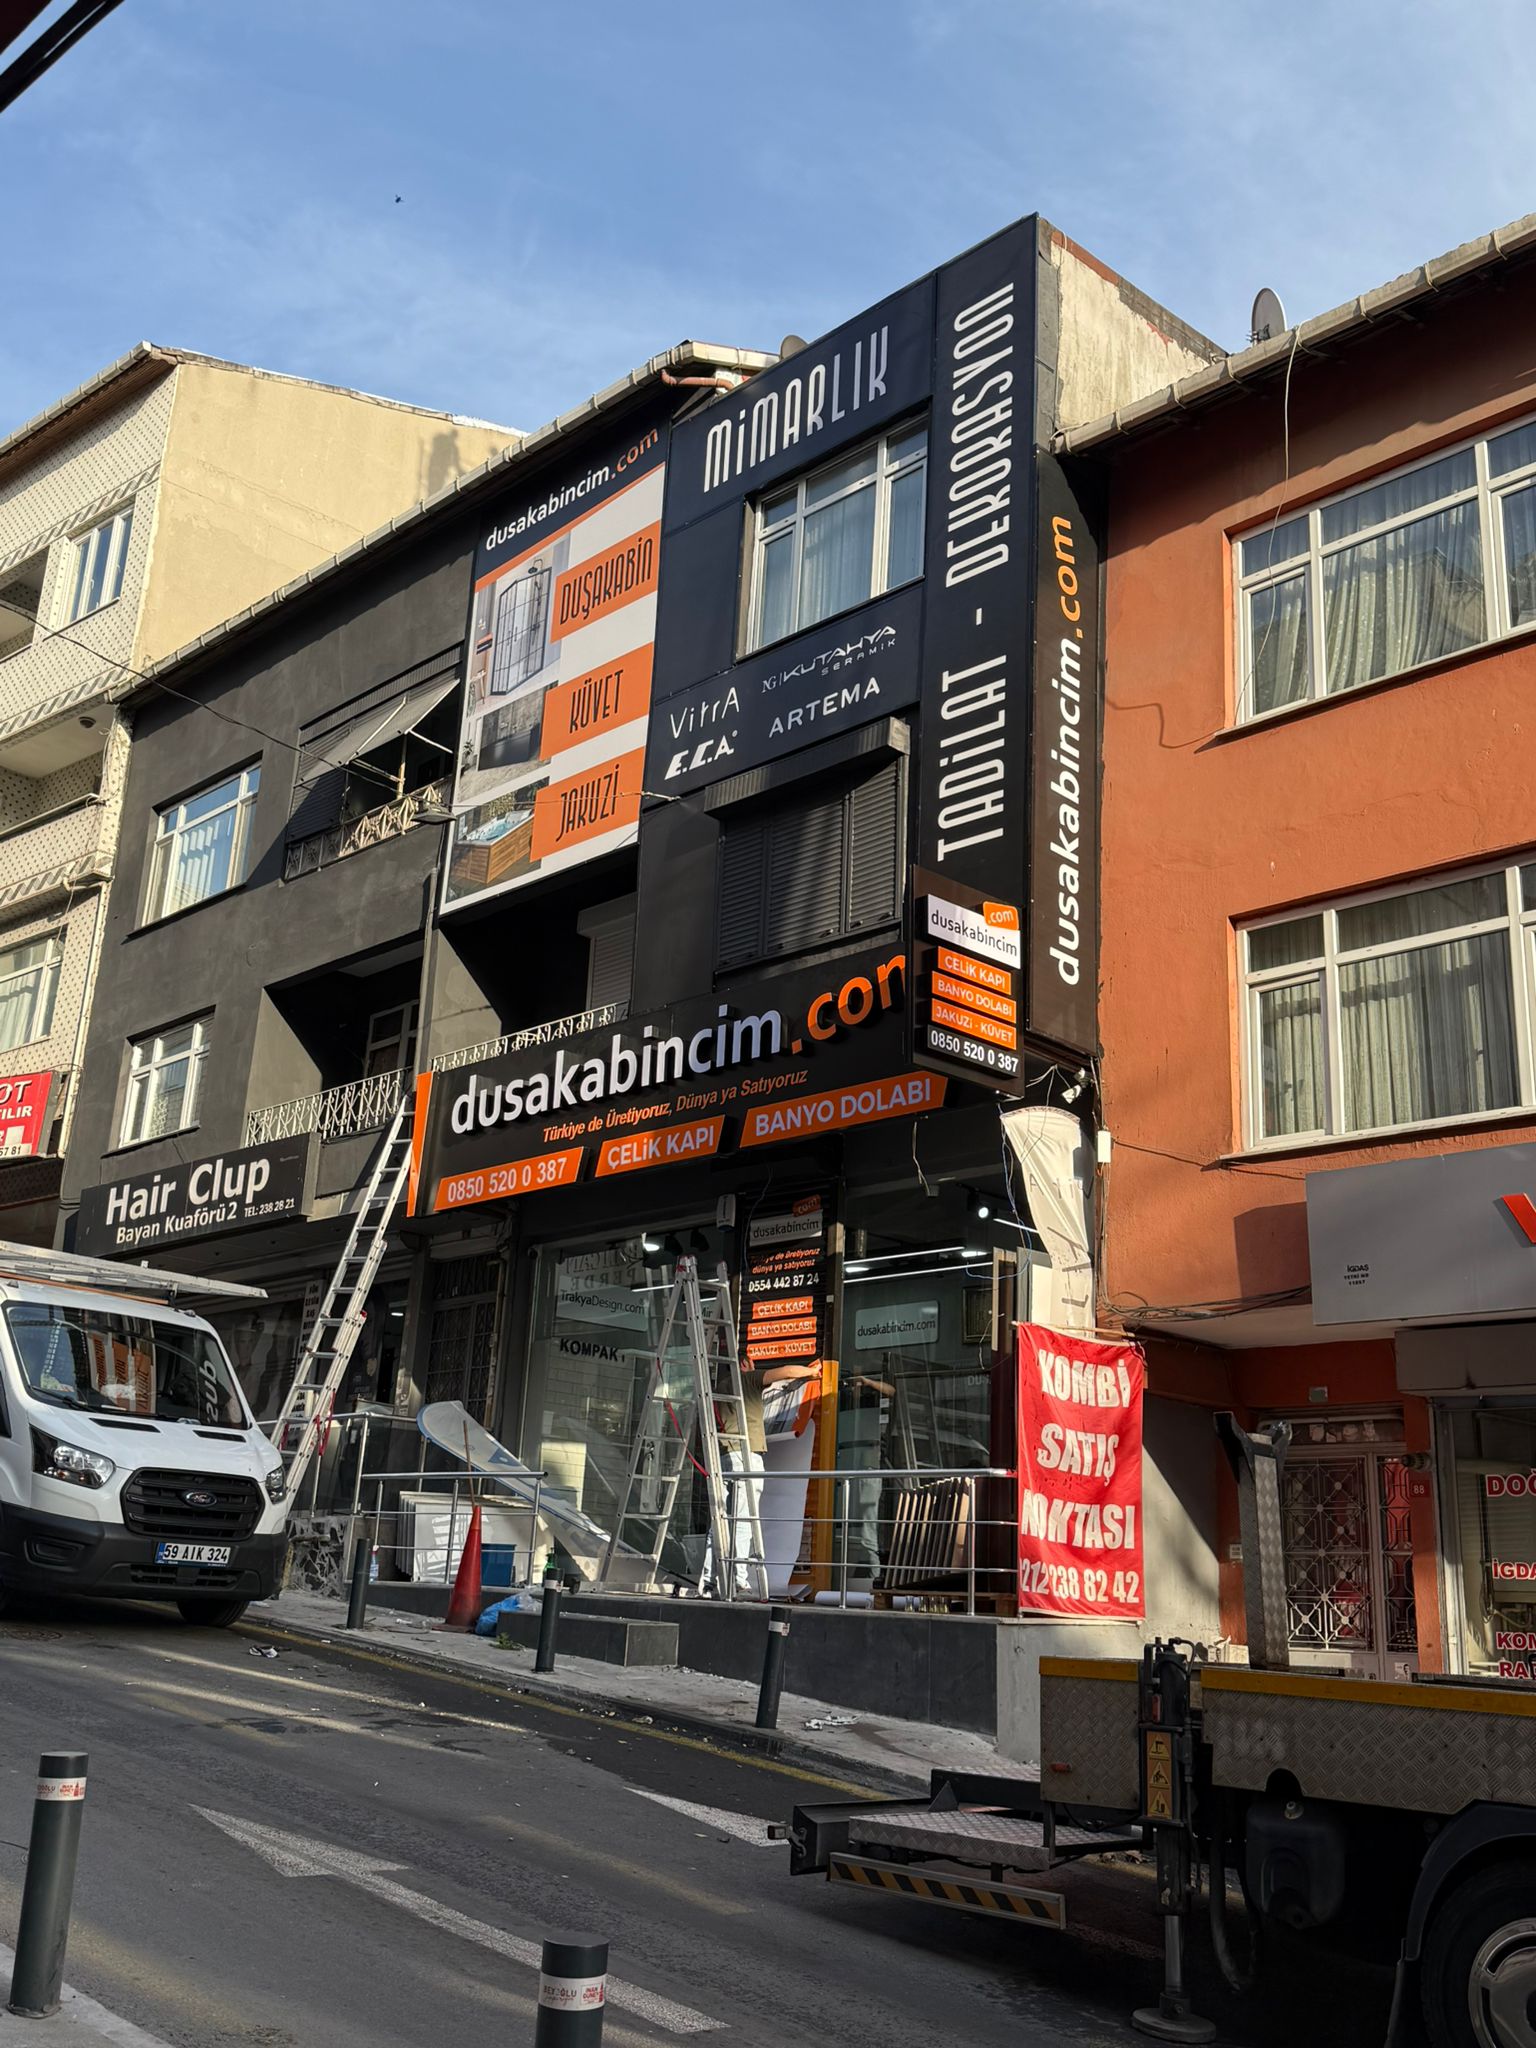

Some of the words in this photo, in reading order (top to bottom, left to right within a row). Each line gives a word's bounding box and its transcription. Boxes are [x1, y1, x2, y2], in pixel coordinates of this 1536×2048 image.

[946, 282, 1014, 588] DEKORASYON
[486, 428, 658, 551] dusakabincim.com
[560, 536, 653, 620] DUŞAKABİN
[569, 669, 624, 734] KÜVET
[670, 686, 740, 739] VitrA
[768, 676, 881, 738] ARTEMA
[1049, 514, 1082, 986] dusakabincim.com
[555, 764, 620, 842] JAKUZİ
[931, 909, 1018, 957] dusakabincim
[987, 909, 1014, 925] .com
[938, 978, 974, 1003] BANYO
[976, 991, 1012, 1017] DOLABI
[979, 967, 1005, 989] KAPI
[931, 1030, 960, 1053] 0850
[963, 1041, 984, 1062] 520
[987, 1049, 995, 1065] 0
[998, 1053, 1019, 1073] 387
[980, 1021, 1013, 1043] KÜVET
[0, 1106, 32, 1120] ILIR
[543, 1124, 585, 1143] Türkiye
[587, 1116, 603, 1131] de
[676, 1088, 718, 1113] Dünya
[721, 1086, 737, 1105] ya
[740, 1069, 808, 1098] Satıyoruz
[755, 1099, 834, 1137] BANYO
[841, 1078, 930, 1119] DOLABI
[666, 1125, 714, 1155] KAPI
[105, 1174, 177, 1226] Hair
[188, 1158, 270, 1205] Clup
[448, 1178, 484, 1204] 0850
[489, 1170, 517, 1194] 520
[522, 1169, 531, 1187] 0
[537, 1157, 567, 1184] 387
[116, 1221, 159, 1245] Bayan
[164, 1203, 226, 1235] Kuaförü
[227, 1201, 238, 1221] 2
[258, 1202, 274, 1216] 238
[274, 1200, 285, 1211] 28
[285, 1197, 295, 1209] 21
[753, 1218, 819, 1239] dusakabincim
[560, 1289, 645, 1316] TrakyaDesign.com
[748, 1278, 771, 1292] 0554
[773, 1276, 791, 1289] 442
[793, 1274, 804, 1286] 87
[807, 1273, 820, 1285] 24
[857, 1319, 936, 1337] dusakabincim.com
[1039, 1348, 1131, 1408] KOMBİ
[1037, 1422, 1119, 1487] SATIŞ
[1413, 1484, 1425, 1494] 88
[164, 1544, 179, 1559] 59
[182, 1546, 204, 1561] AIK
[207, 1548, 227, 1562] 324
[1083, 1568, 1109, 1602] 82
[1113, 1570, 1140, 1604] 42
